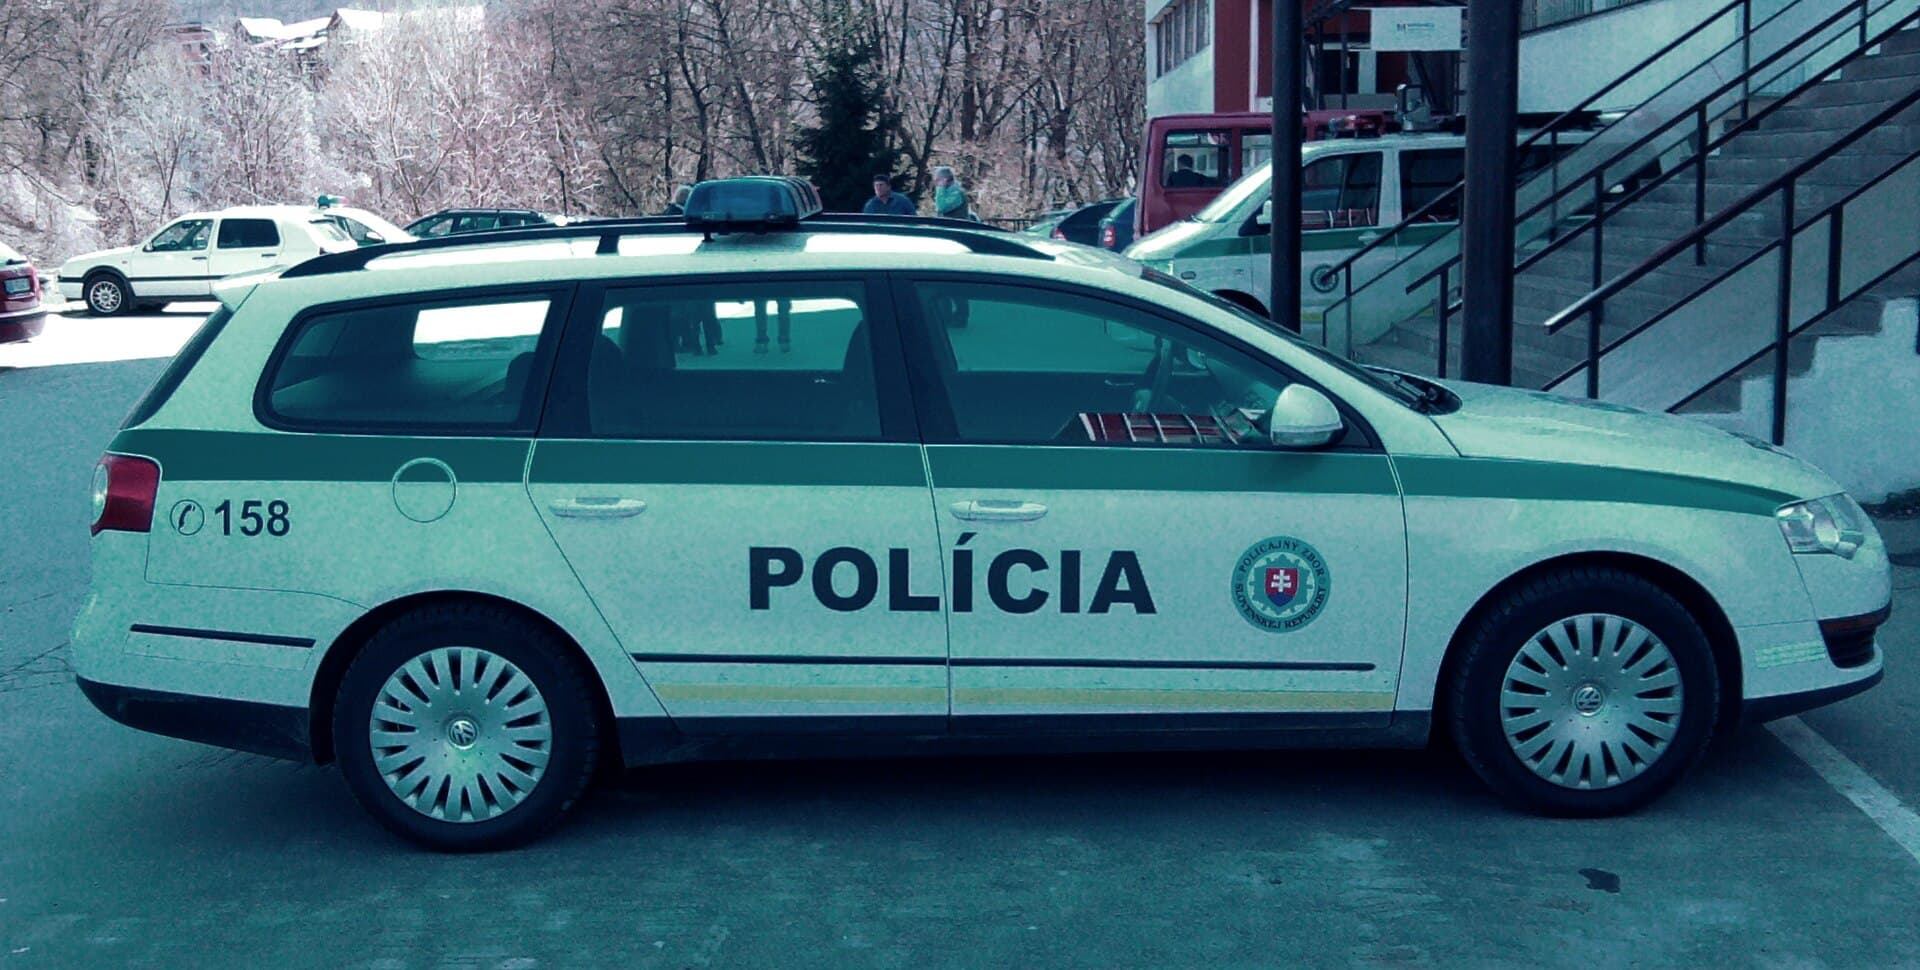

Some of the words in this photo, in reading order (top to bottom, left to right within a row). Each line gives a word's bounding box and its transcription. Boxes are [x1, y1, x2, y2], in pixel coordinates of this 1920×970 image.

[214, 499, 291, 537] 158
[748, 532, 1157, 615] POLÍCIA
[1302, 548, 1326, 577] ZBOR
